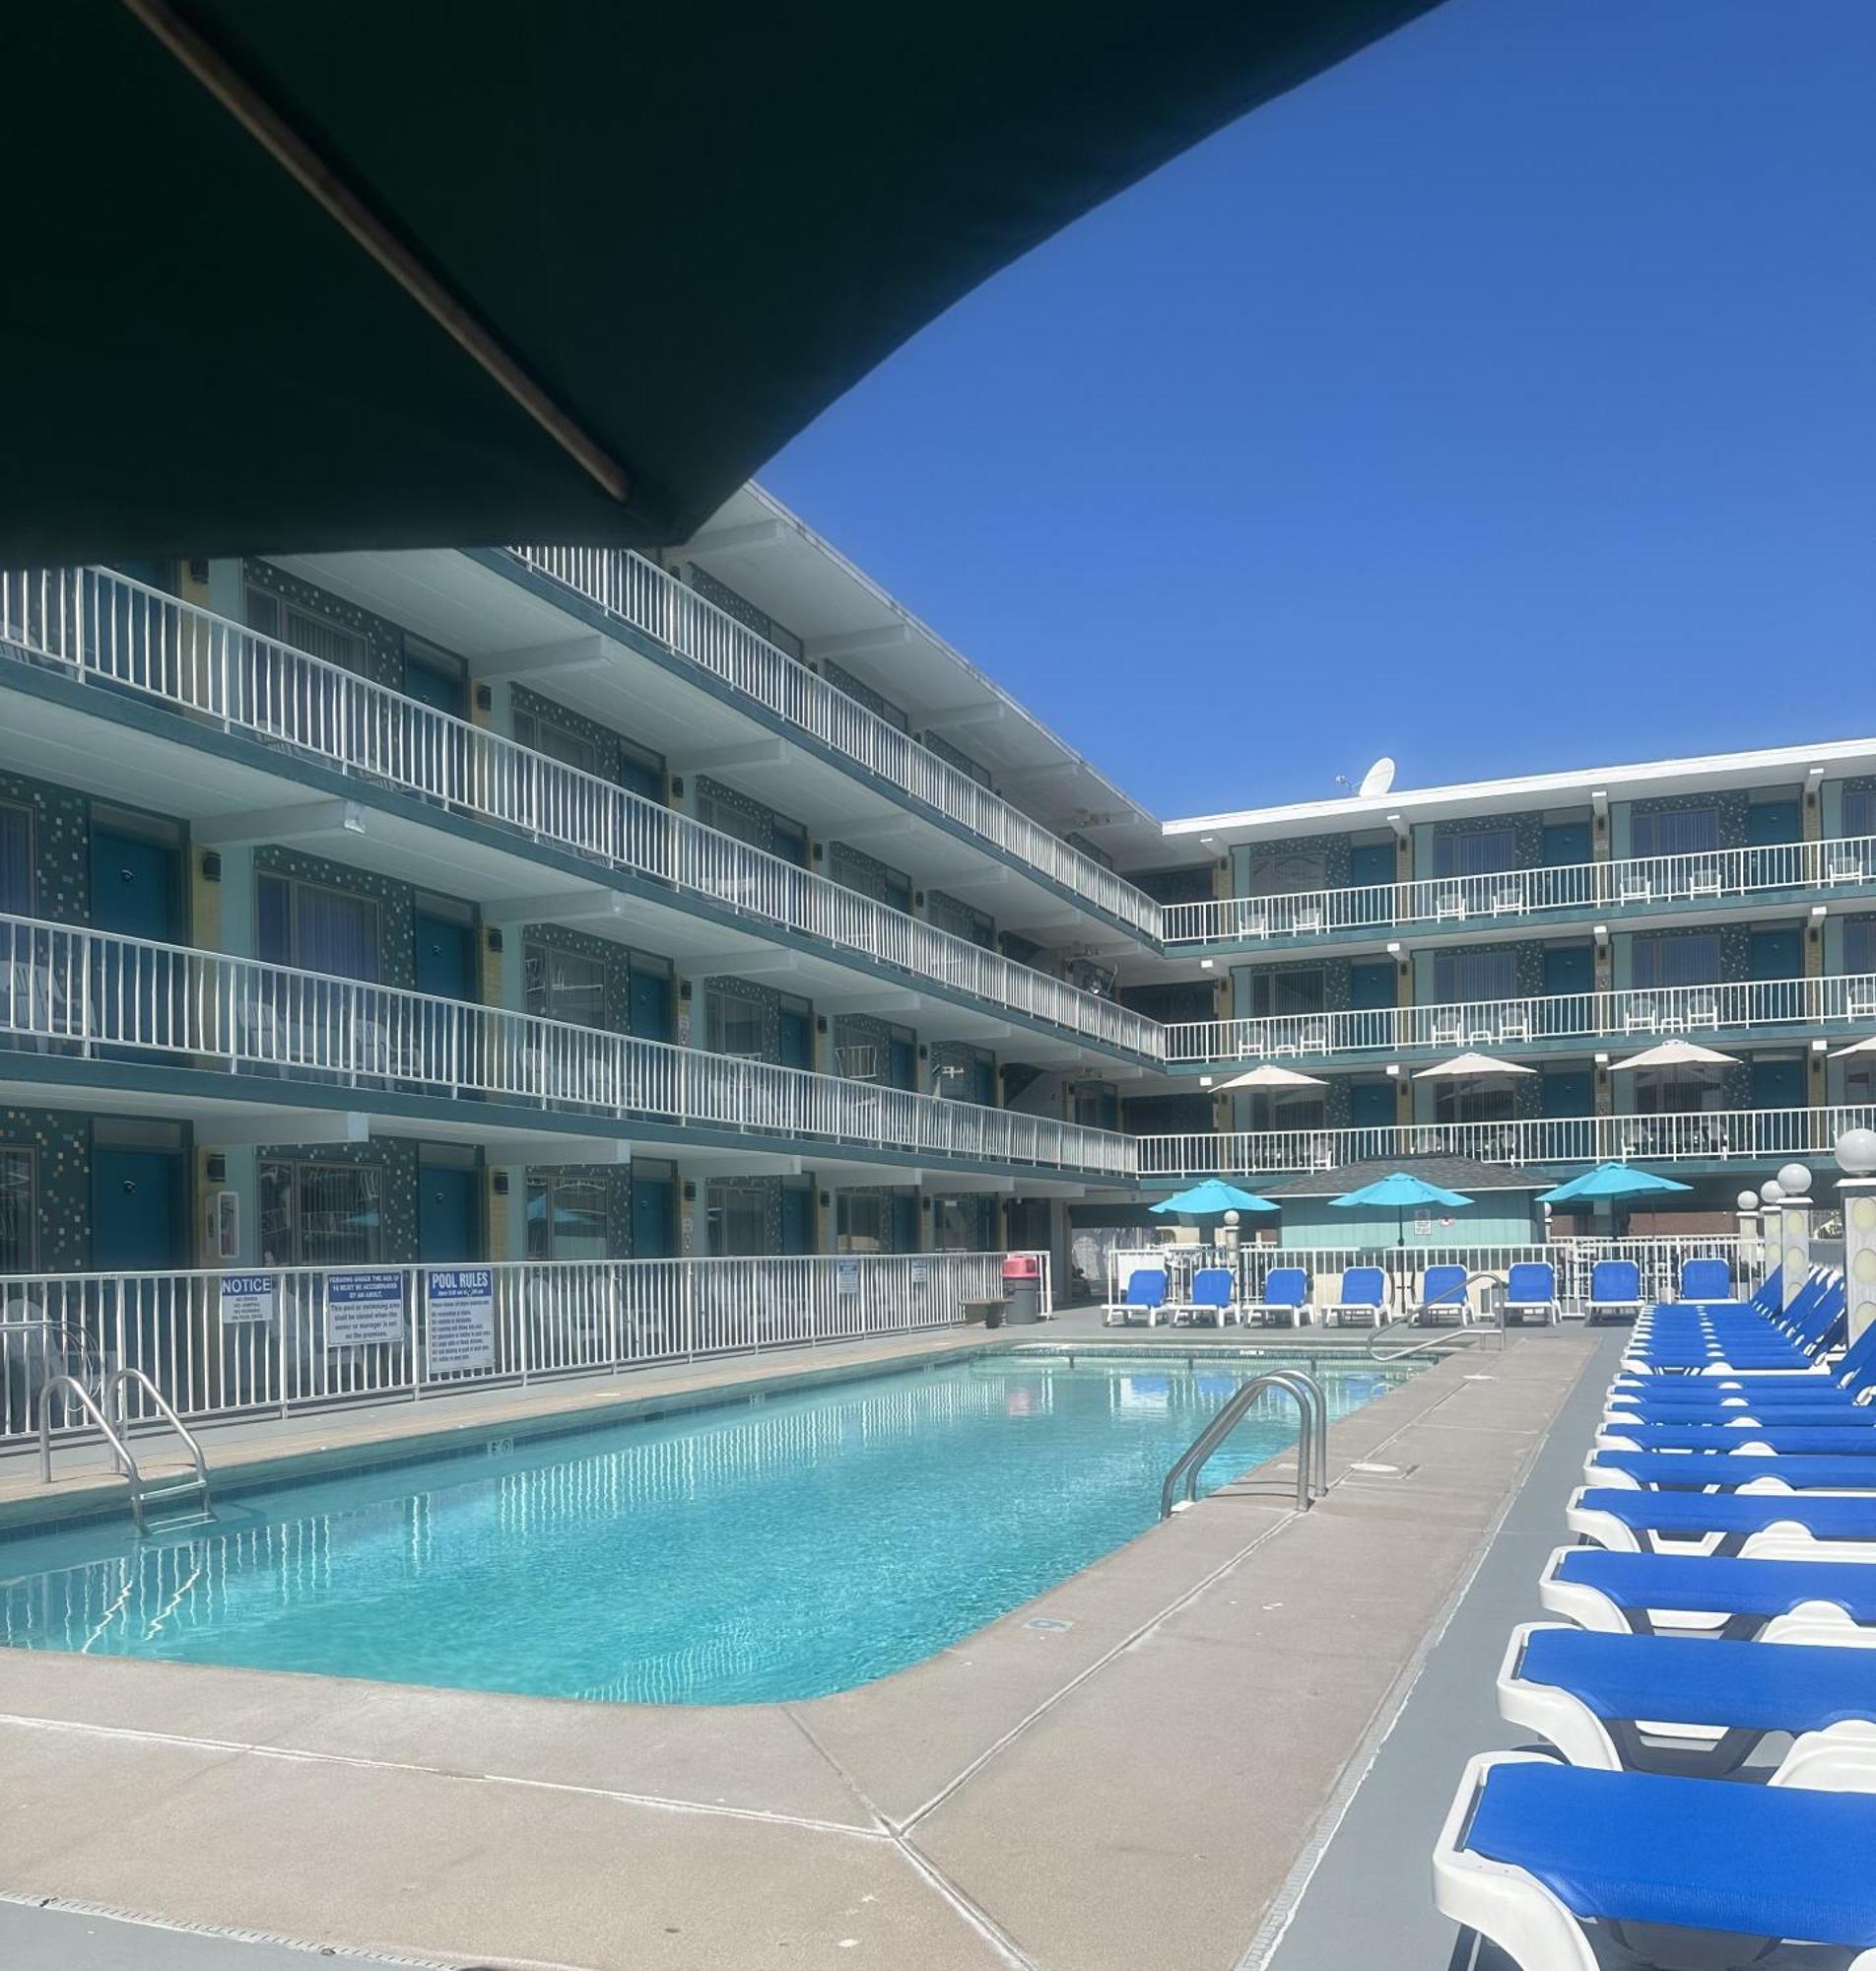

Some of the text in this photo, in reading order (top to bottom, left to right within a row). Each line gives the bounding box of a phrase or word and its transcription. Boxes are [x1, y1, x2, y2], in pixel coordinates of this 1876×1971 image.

[223, 1278, 271, 1293] NOTICE
[433, 1272, 489, 1289] POOL RULES
